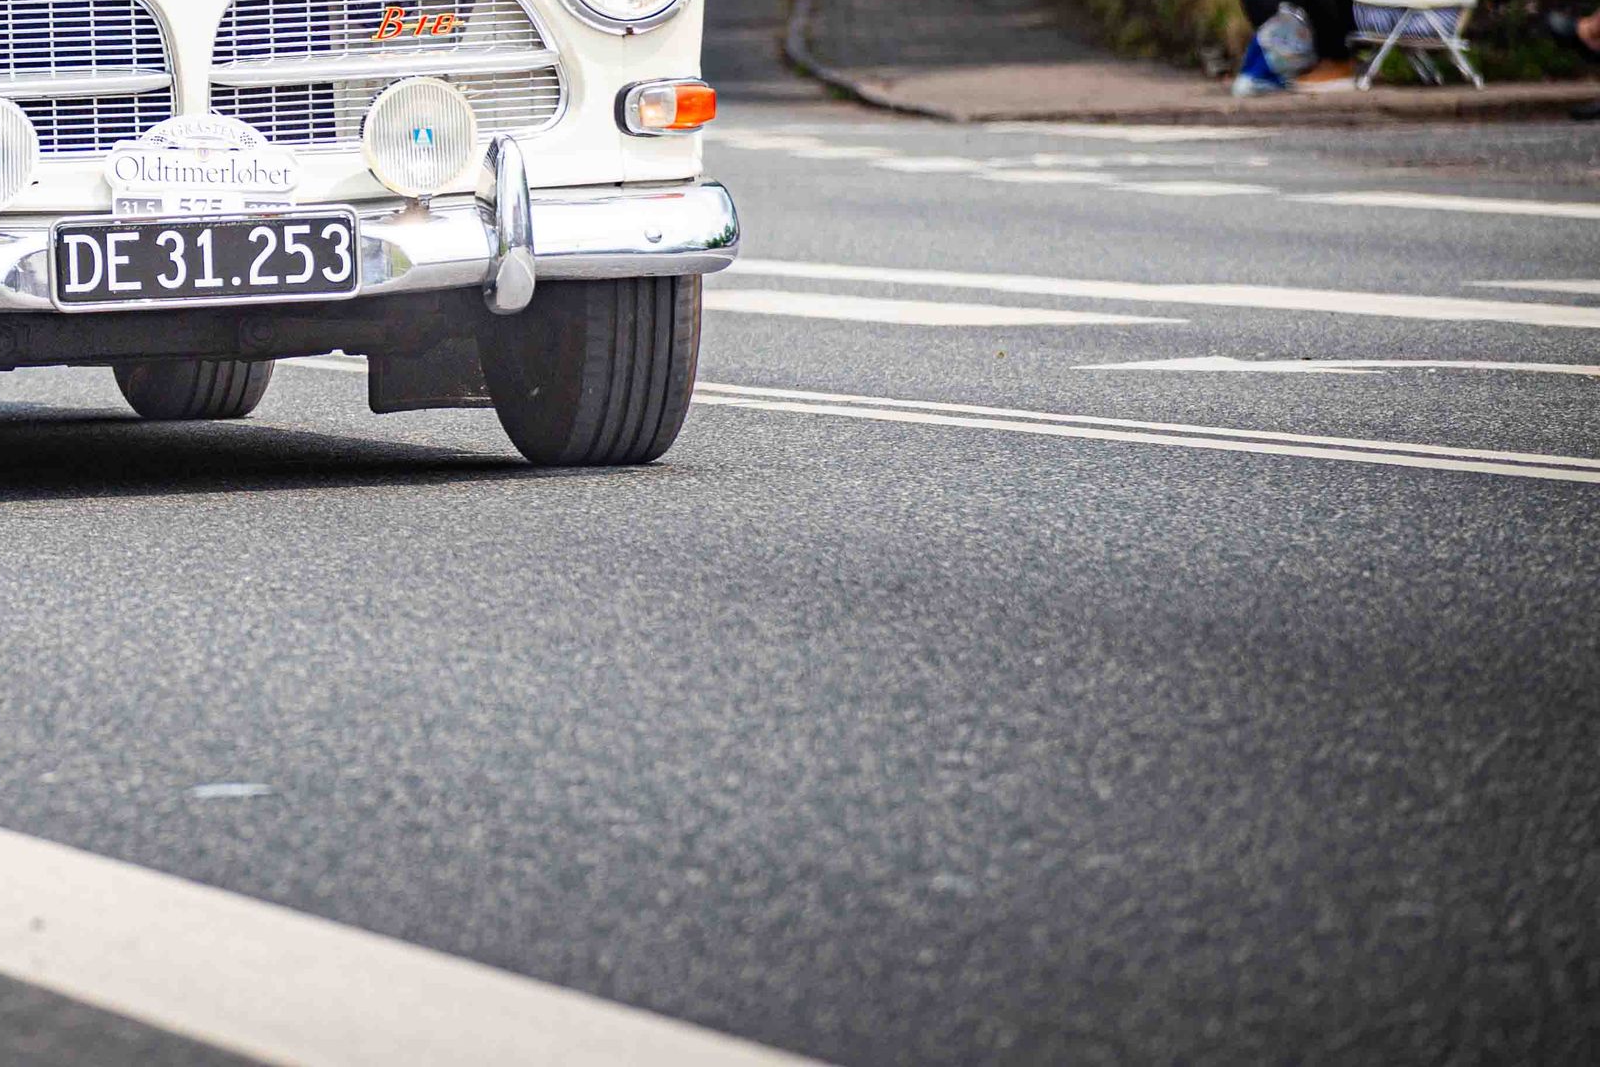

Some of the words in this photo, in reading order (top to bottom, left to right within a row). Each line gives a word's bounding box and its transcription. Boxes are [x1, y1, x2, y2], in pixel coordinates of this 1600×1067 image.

[115, 155, 291, 185] Oldtimerløbet
[63, 231, 143, 293] DE
[155, 223, 352, 289] 31.253
